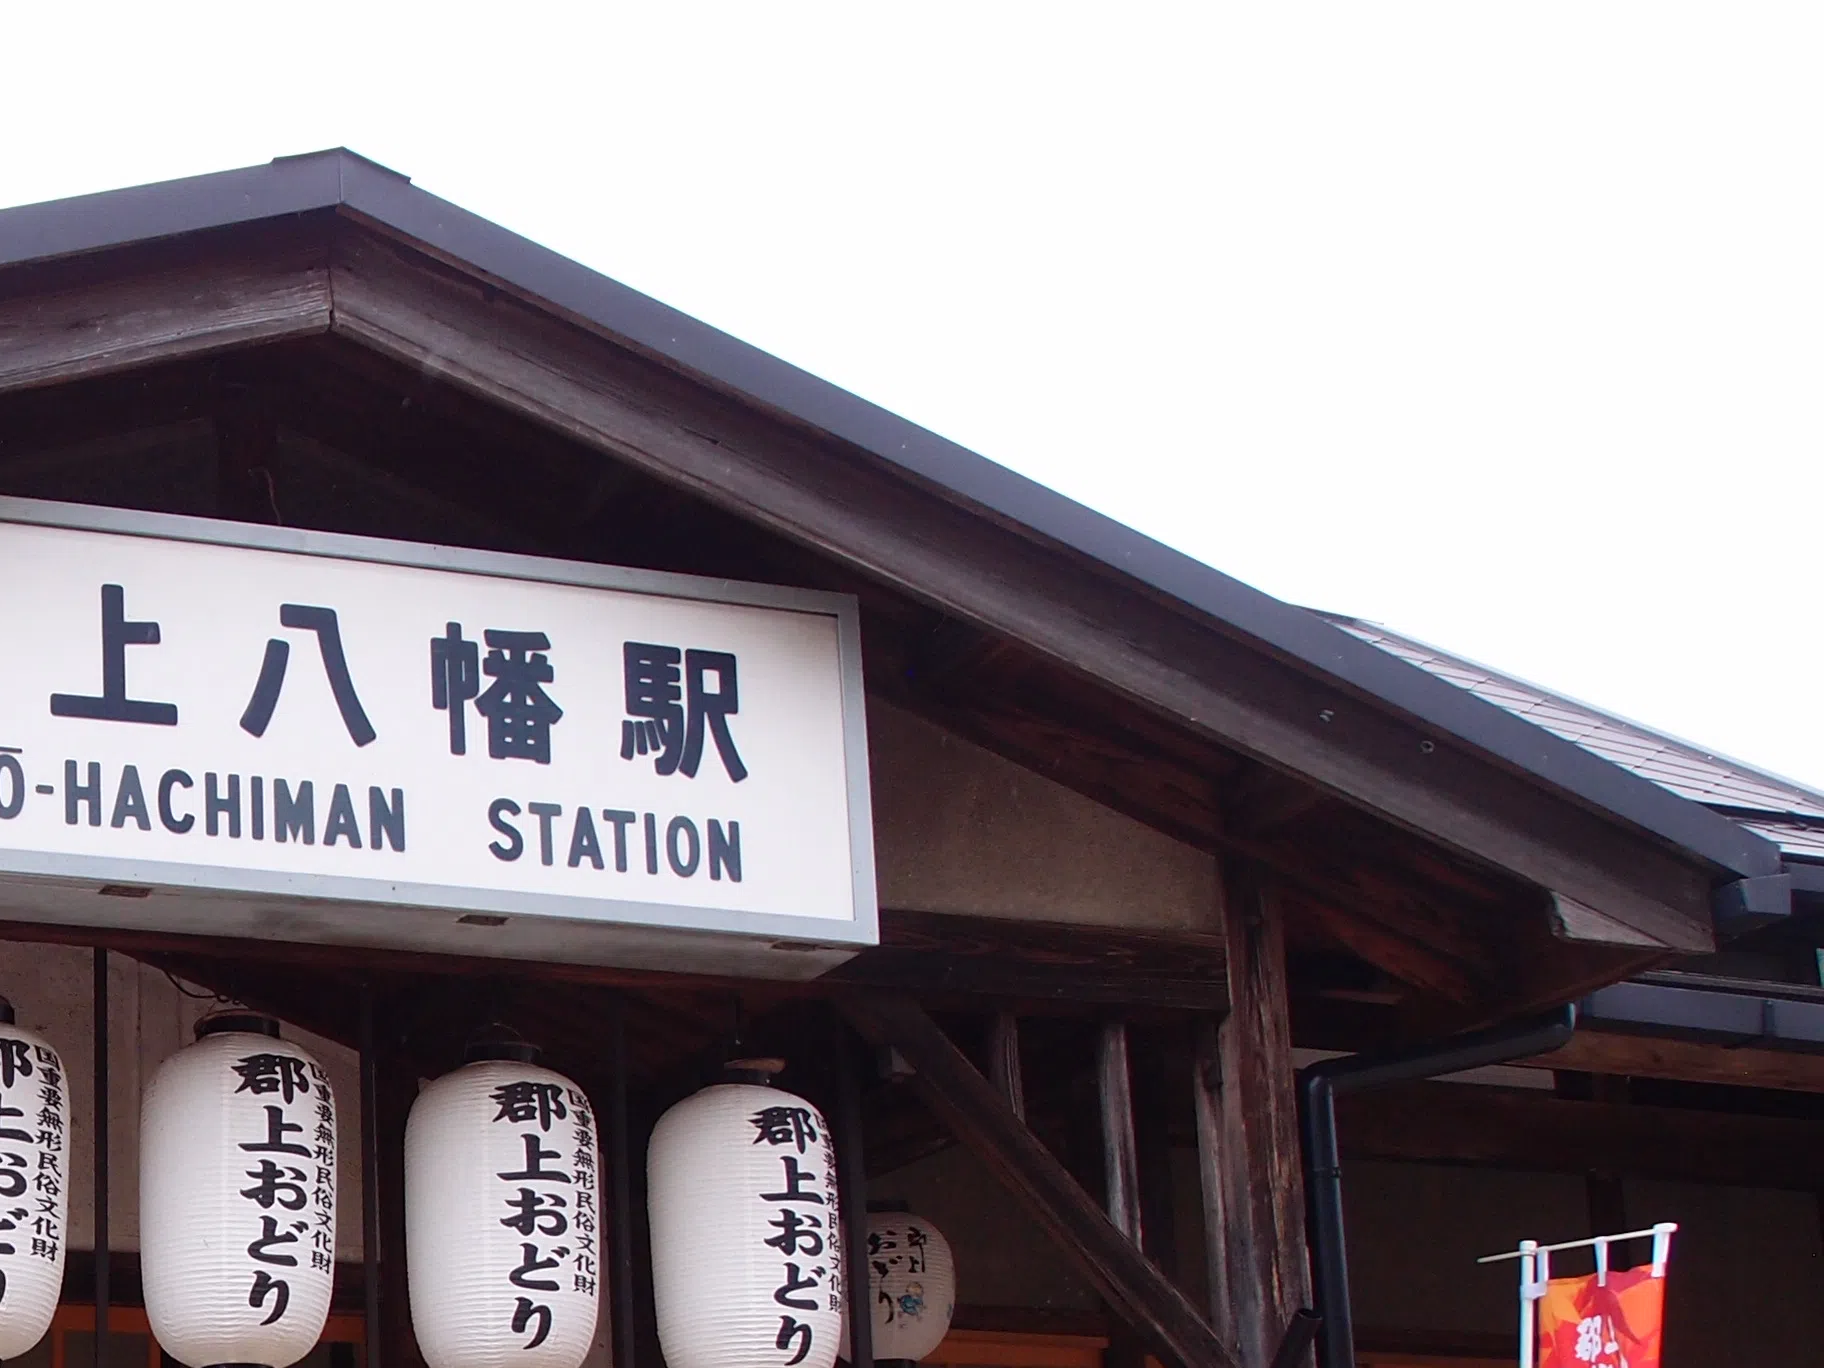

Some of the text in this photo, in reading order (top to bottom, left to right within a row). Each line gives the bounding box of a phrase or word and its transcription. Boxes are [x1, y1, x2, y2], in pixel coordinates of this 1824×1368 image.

[487, 797, 745, 883] STATION
[29, 1045, 64, 1264] 国重要無形民俗文化財
[231, 1054, 312, 1325] 郡上おどり
[492, 1081, 571, 1350] 郡上おどり
[749, 1106, 826, 1367] 郡上おどり
